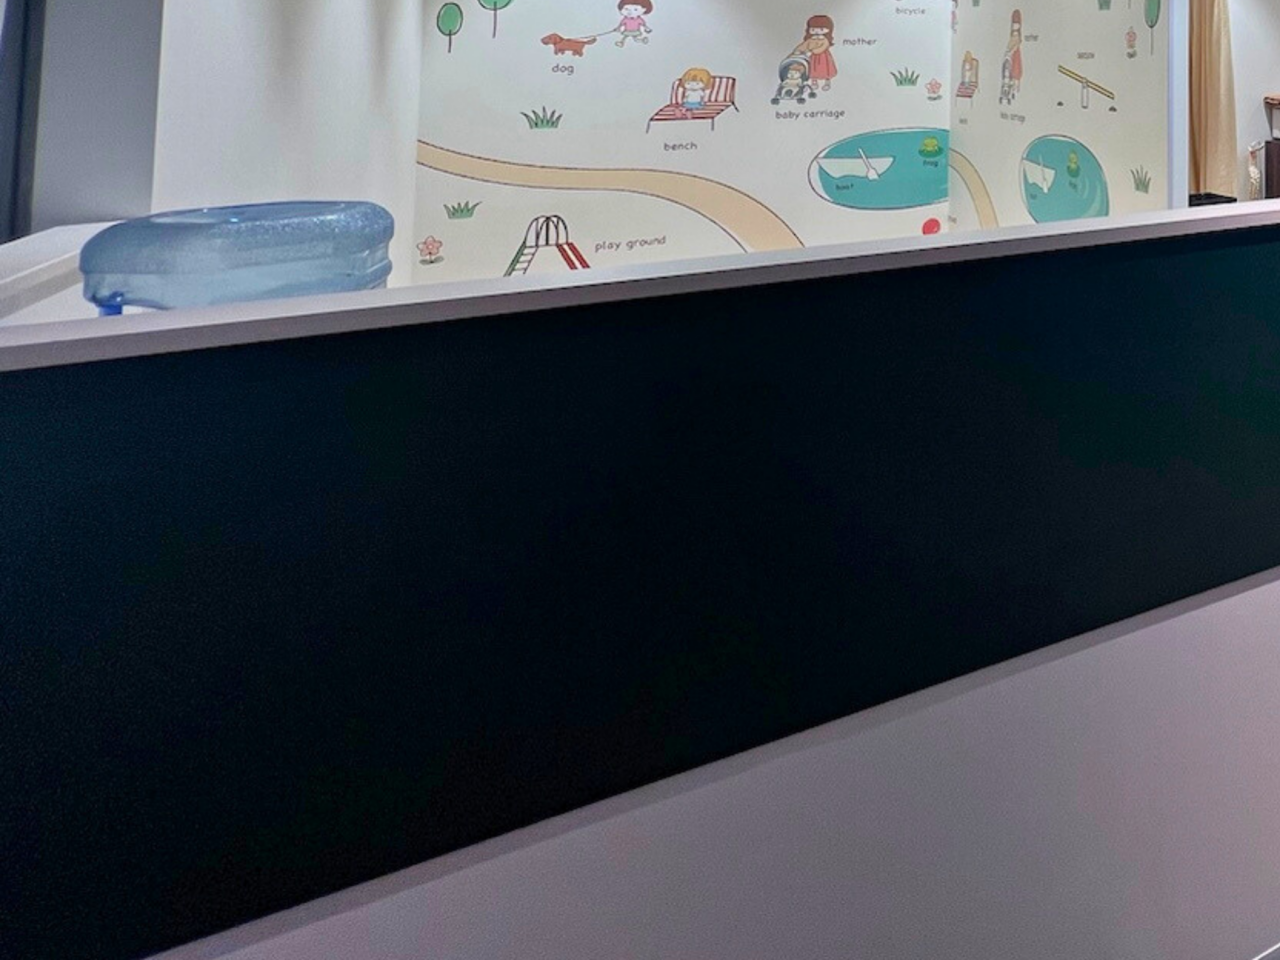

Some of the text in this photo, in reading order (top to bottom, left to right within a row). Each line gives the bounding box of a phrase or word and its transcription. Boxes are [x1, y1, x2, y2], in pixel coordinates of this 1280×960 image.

[895, 7, 926, 16] bicycle
[842, 37, 877, 46] mother
[551, 63, 575, 76] dog
[775, 110, 846, 121] baby carriage
[664, 142, 698, 152] bench
[594, 235, 666, 253] play ground
